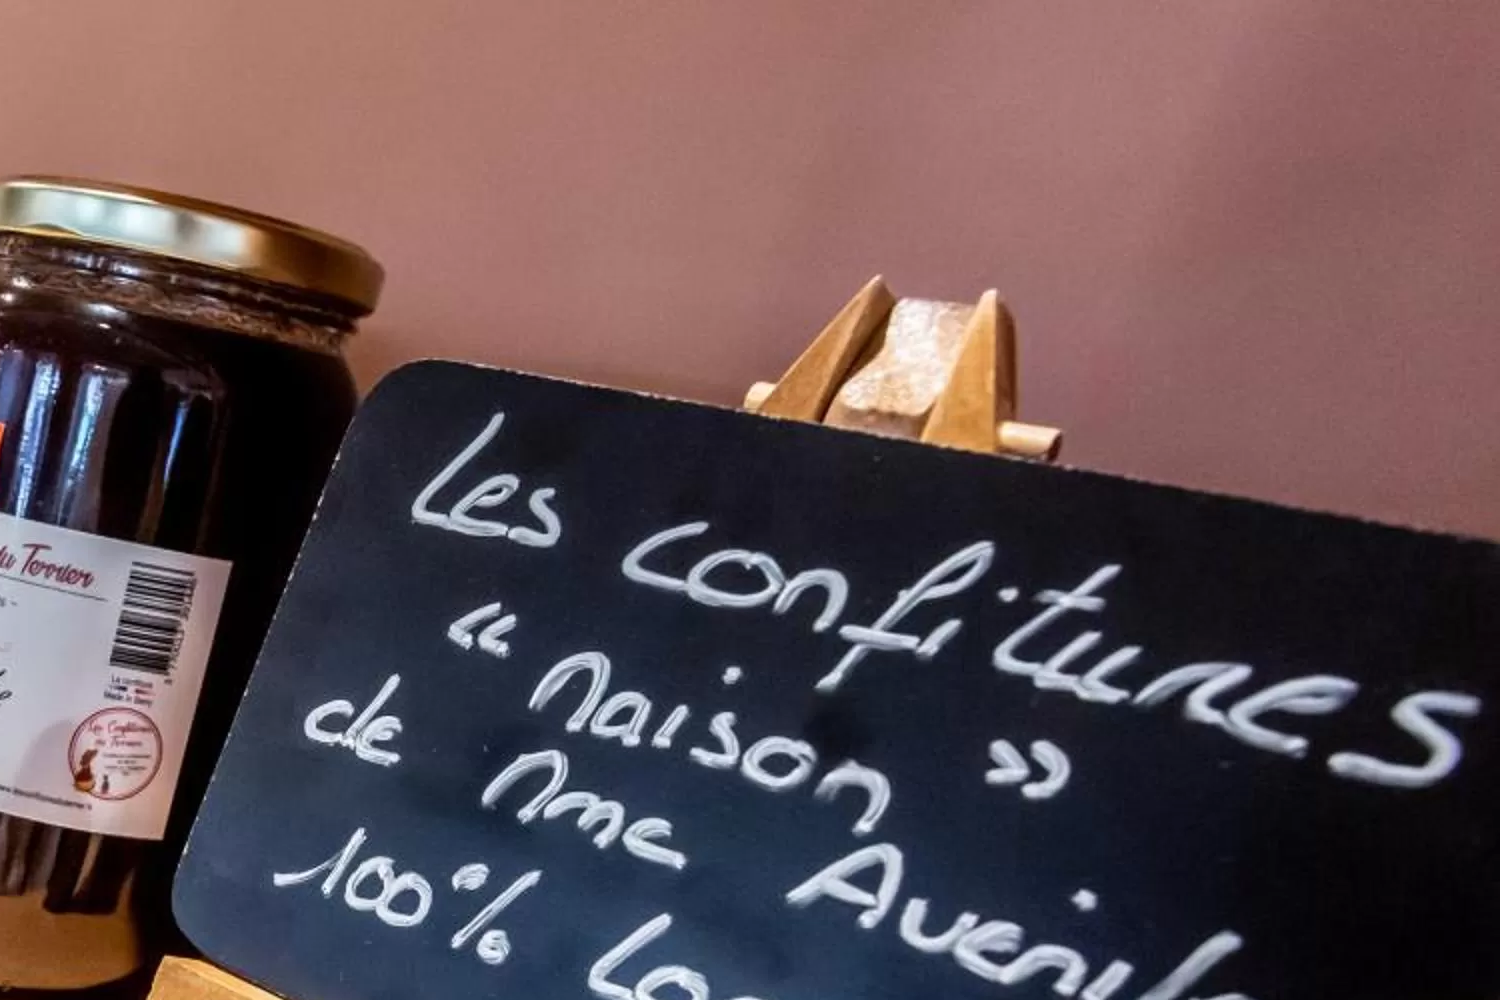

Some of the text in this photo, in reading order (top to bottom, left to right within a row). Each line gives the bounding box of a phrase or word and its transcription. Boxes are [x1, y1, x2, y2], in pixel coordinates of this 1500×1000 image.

[411, 411, 562, 548] Les
[303, 672, 402, 768] de
[272, 826, 543, 966] 100%
